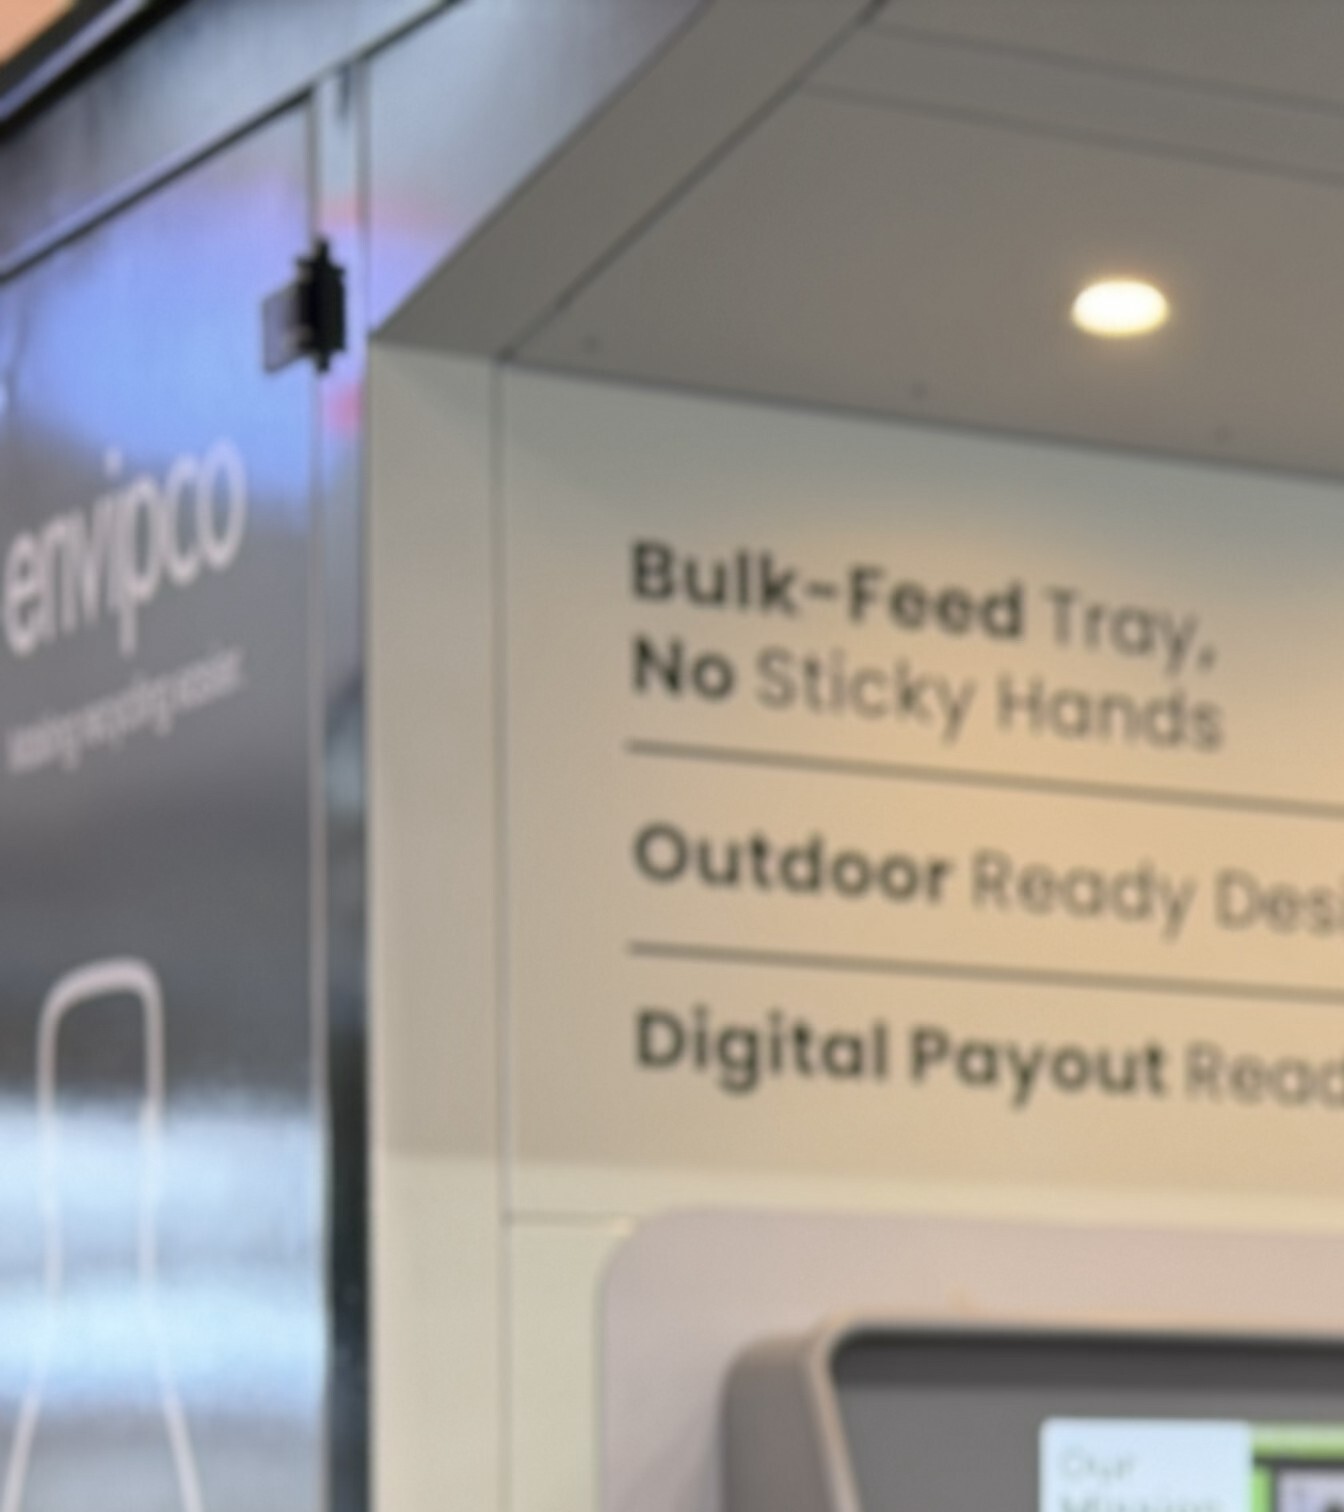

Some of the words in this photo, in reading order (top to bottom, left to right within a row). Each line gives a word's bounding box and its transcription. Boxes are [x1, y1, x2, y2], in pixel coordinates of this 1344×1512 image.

[3, 437, 247, 655] envipco
[629, 541, 1025, 641] Bulk-Feed
[1043, 587, 1219, 676] Tray,
[629, 636, 735, 702] No
[753, 647, 974, 742] Sticky
[996, 674, 1225, 753] Hands
[631, 823, 950, 904] Outdoor
[971, 849, 1198, 940] Ready
[634, 1004, 887, 1095] Digital
[909, 1025, 1165, 1112] Payout
